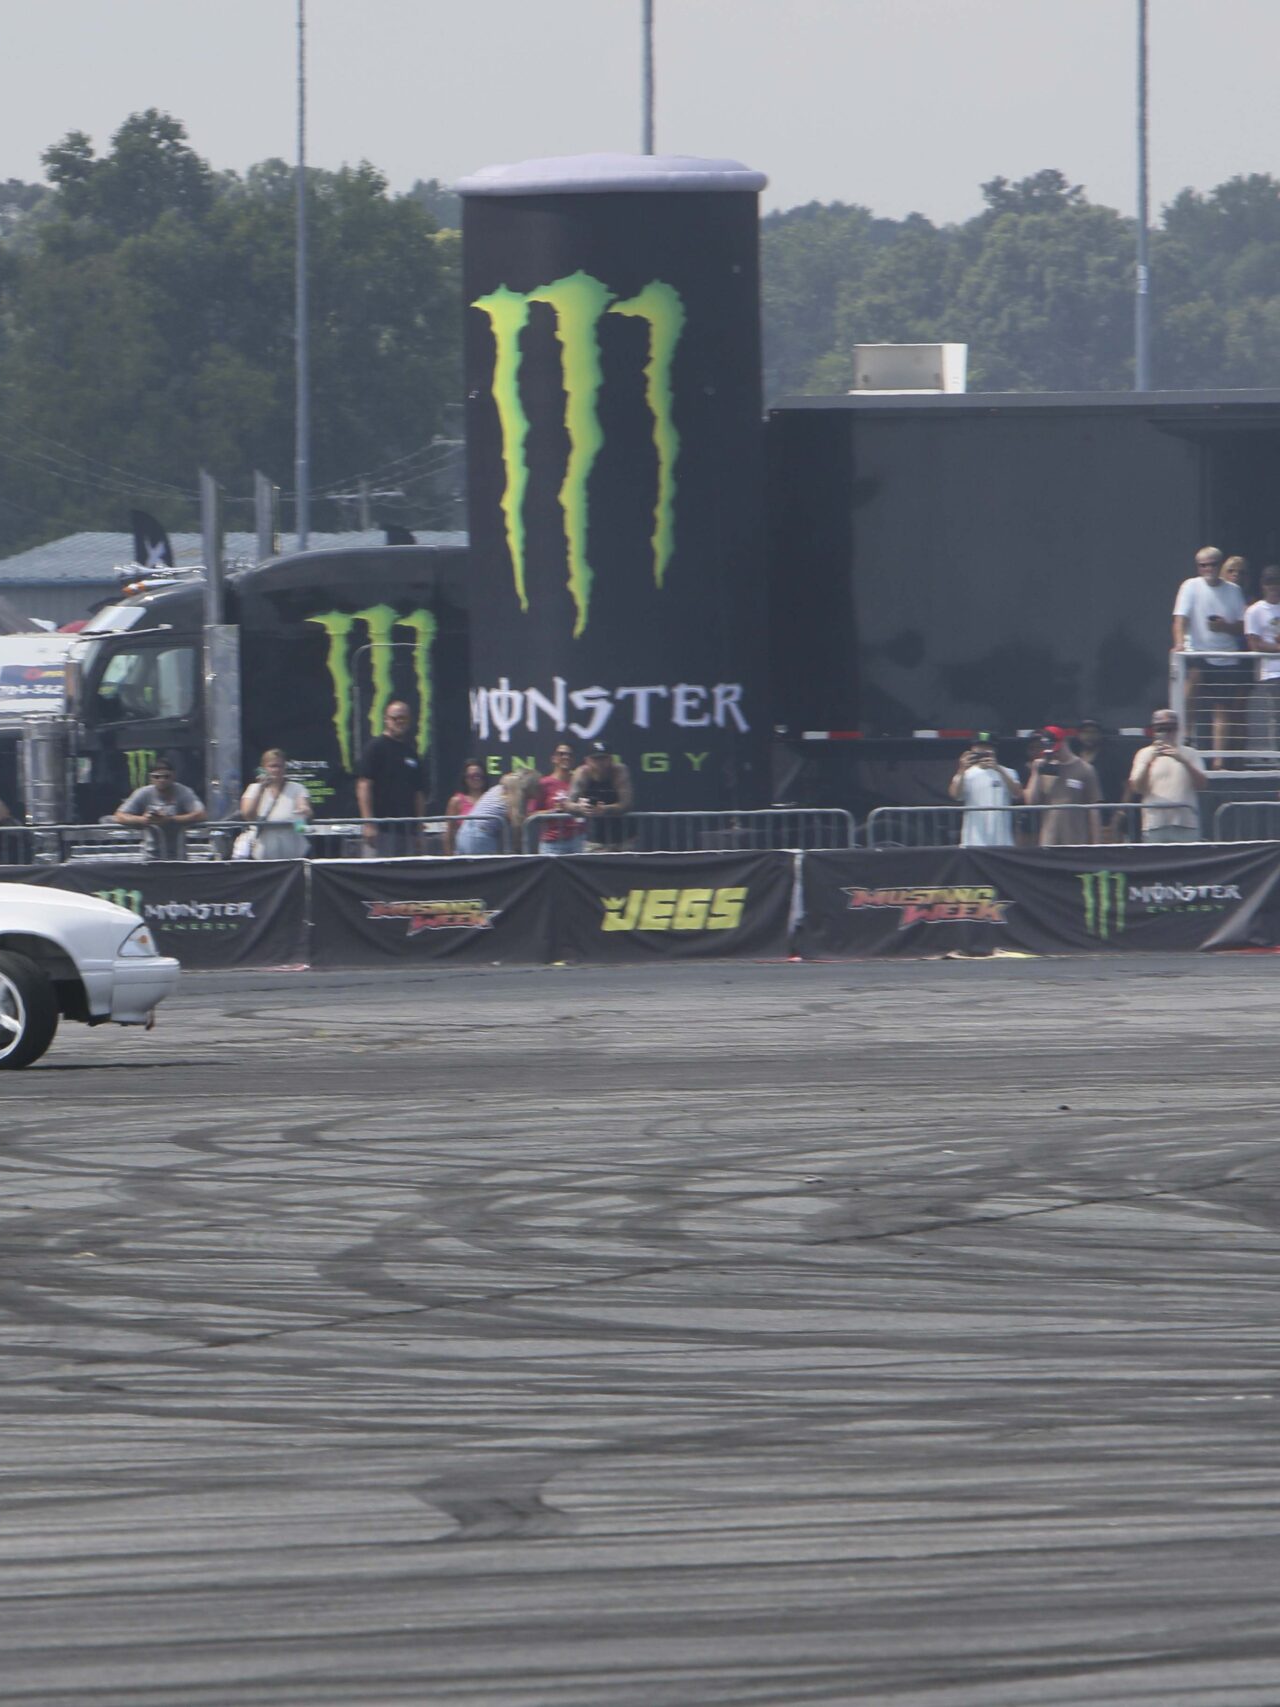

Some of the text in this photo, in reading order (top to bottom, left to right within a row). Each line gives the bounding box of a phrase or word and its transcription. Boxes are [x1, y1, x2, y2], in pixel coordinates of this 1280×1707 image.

[469, 676, 750, 742] MONSTER
[285, 760, 329, 769] NSTER
[486, 752, 709, 775] ENGY
[1128, 882, 1243, 904] MONSTER
[144, 900, 256, 920] MONSTER
[600, 887, 749, 931] JEGS
[899, 902, 1014, 930] WEEK
